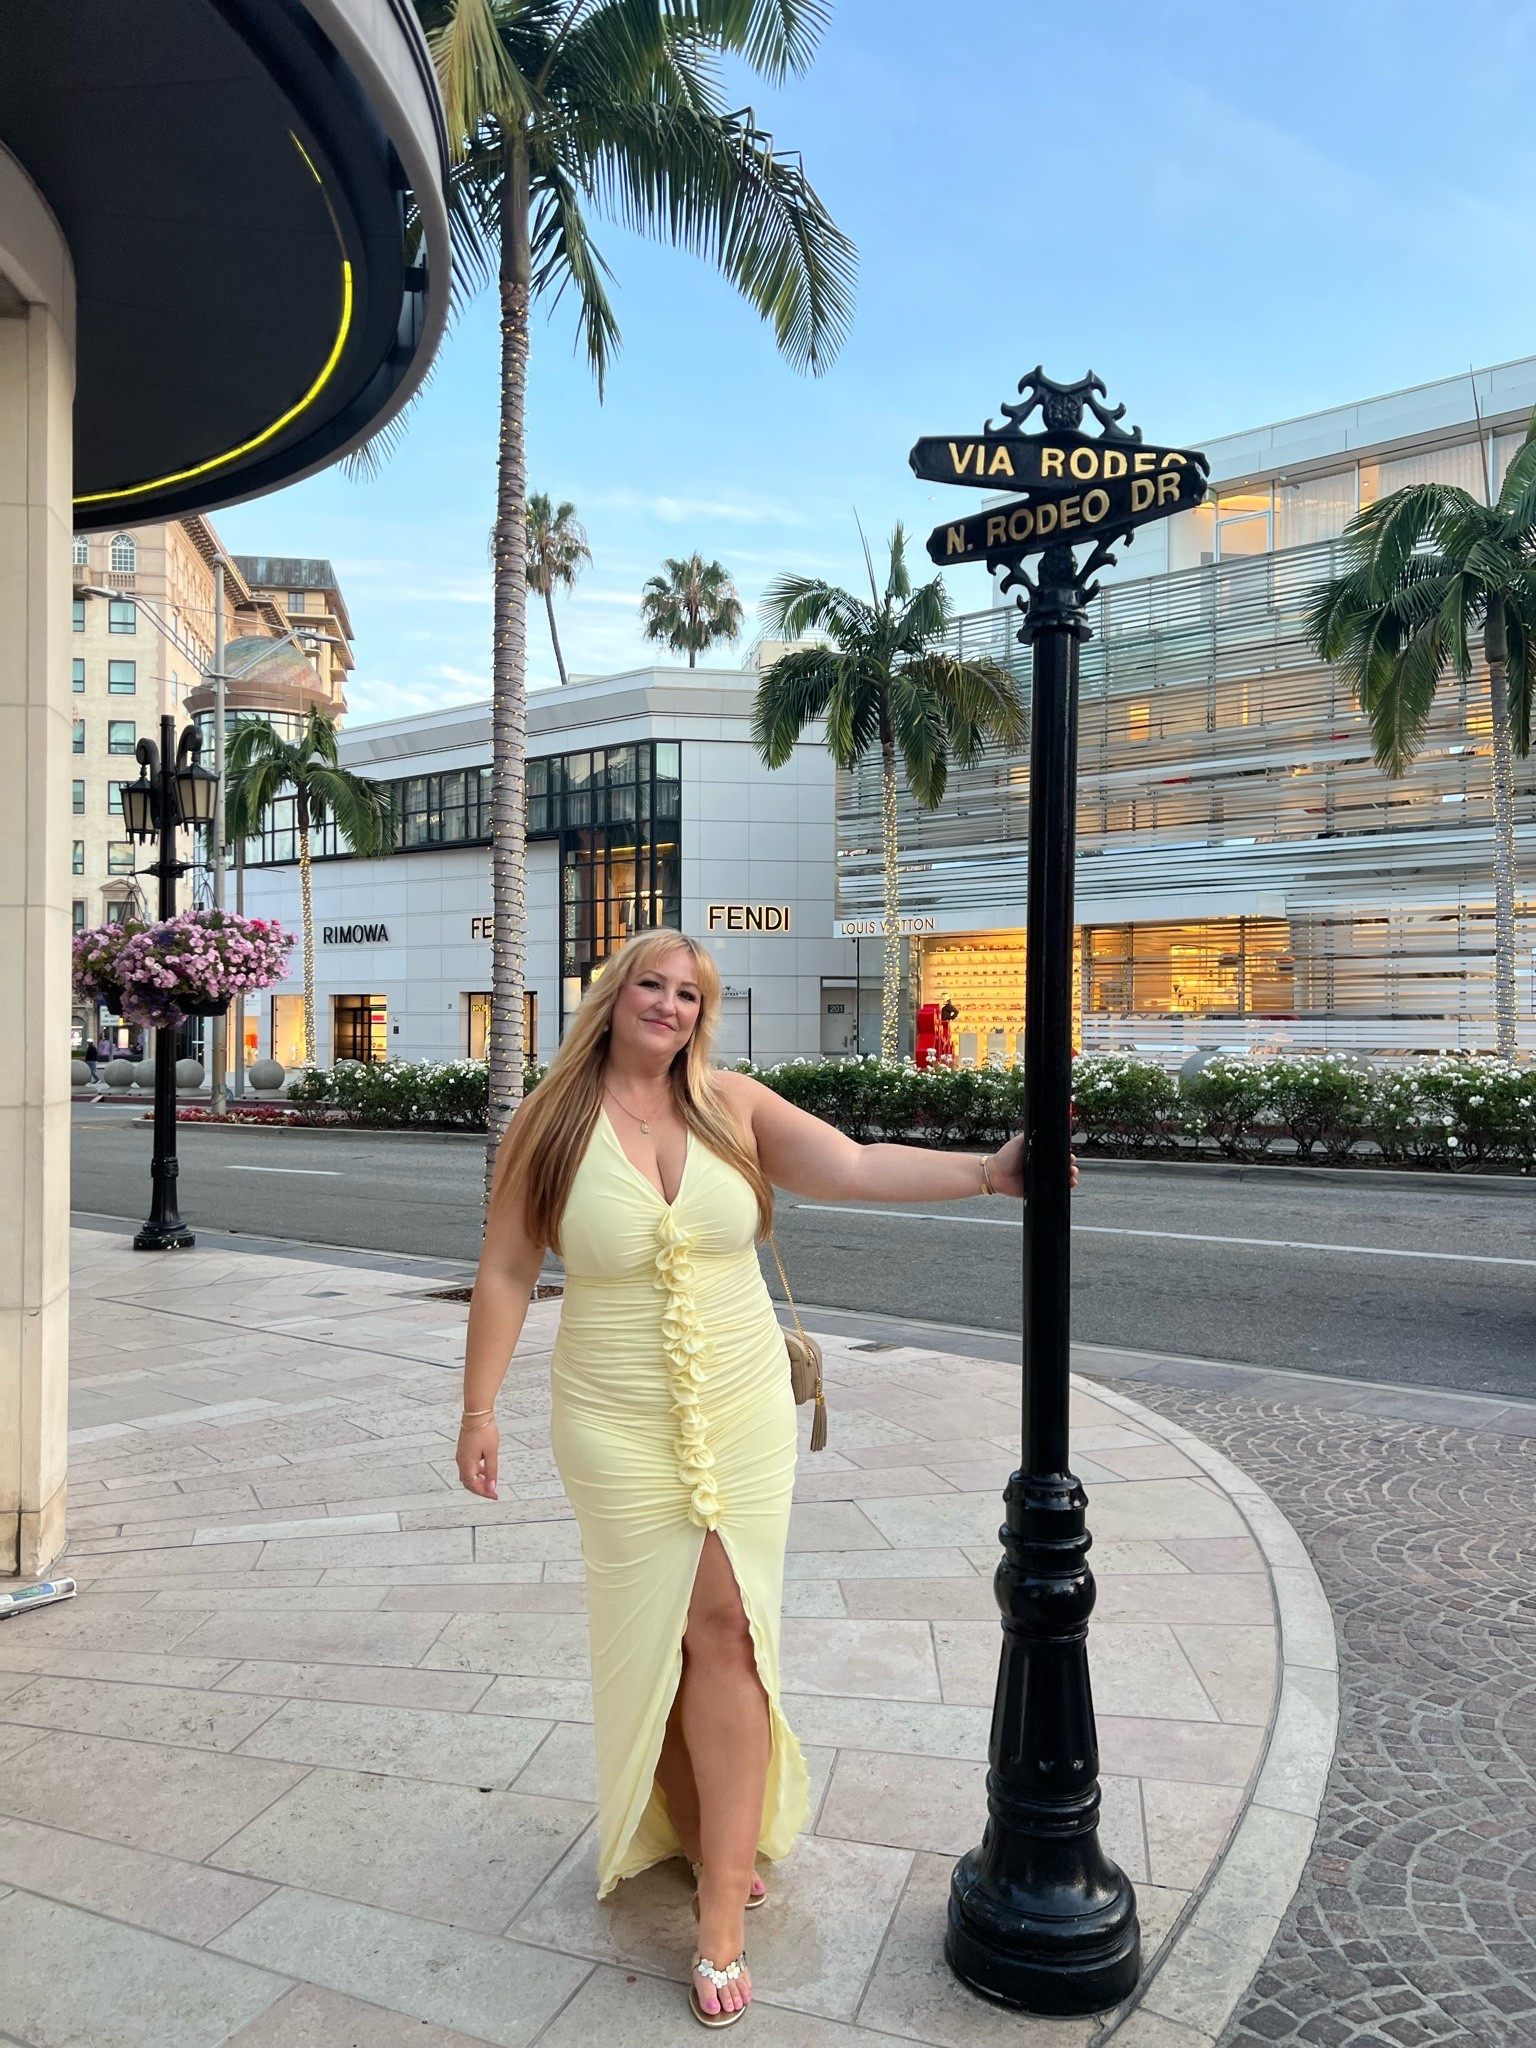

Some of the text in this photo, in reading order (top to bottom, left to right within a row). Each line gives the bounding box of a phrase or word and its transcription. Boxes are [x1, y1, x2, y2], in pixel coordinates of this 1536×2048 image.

[948, 442, 1015, 477] VIA
[946, 471, 1181, 555] N. RODEO DR
[708, 905, 790, 931] FENDI
[841, 921, 876, 935] LOUIS
[323, 923, 389, 944] RIMOWA
[829, 1005, 843, 1013] 201
